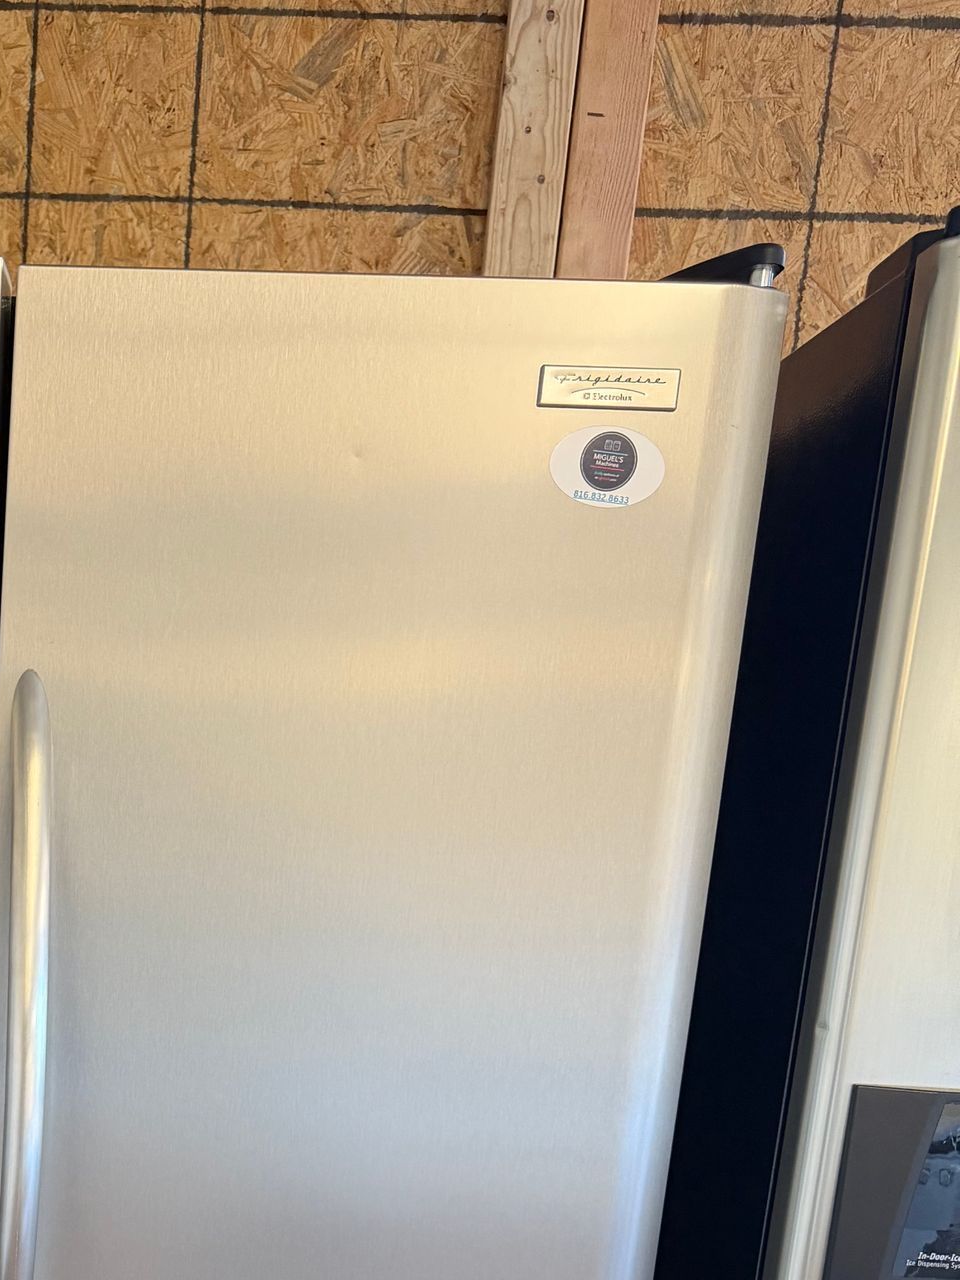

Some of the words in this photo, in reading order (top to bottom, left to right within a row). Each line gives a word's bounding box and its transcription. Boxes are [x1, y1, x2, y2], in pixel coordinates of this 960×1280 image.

[554, 373, 667, 386] Frigidaire
[592, 392, 633, 402] Electrolux
[593, 453, 624, 463] MIGUEL'S
[573, 489, 630, 505] 816.832.8633
[917, 1260, 950, 1270] Dispensing
